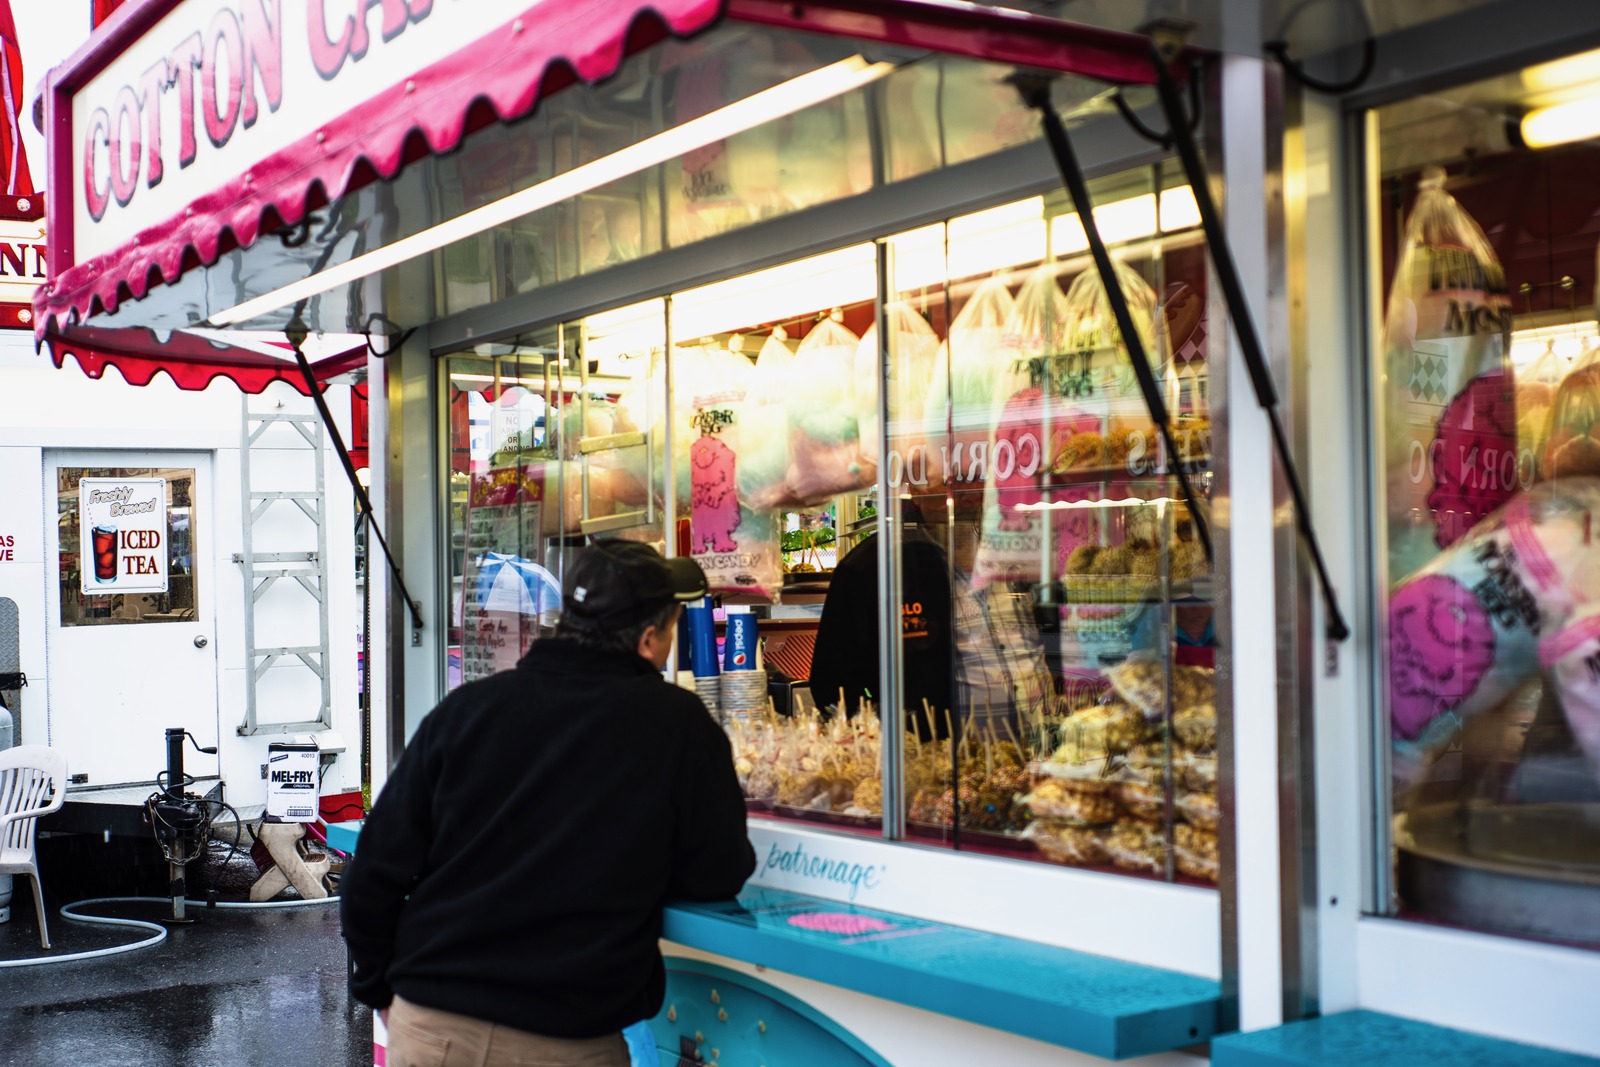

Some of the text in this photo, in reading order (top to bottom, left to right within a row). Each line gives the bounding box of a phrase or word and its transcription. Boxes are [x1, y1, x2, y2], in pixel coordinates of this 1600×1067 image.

[84, 0, 283, 223] COTTON
[505, 416, 519, 425] NO
[89, 485, 134, 504] Freshly
[110, 497, 156, 517] Brewed
[120, 530, 160, 549] ICED
[123, 555, 159, 575] TEA
[714, 553, 761, 569] CANDY
[734, 619, 745, 650] pepsi
[271, 770, 313, 782] MEL-FRY
